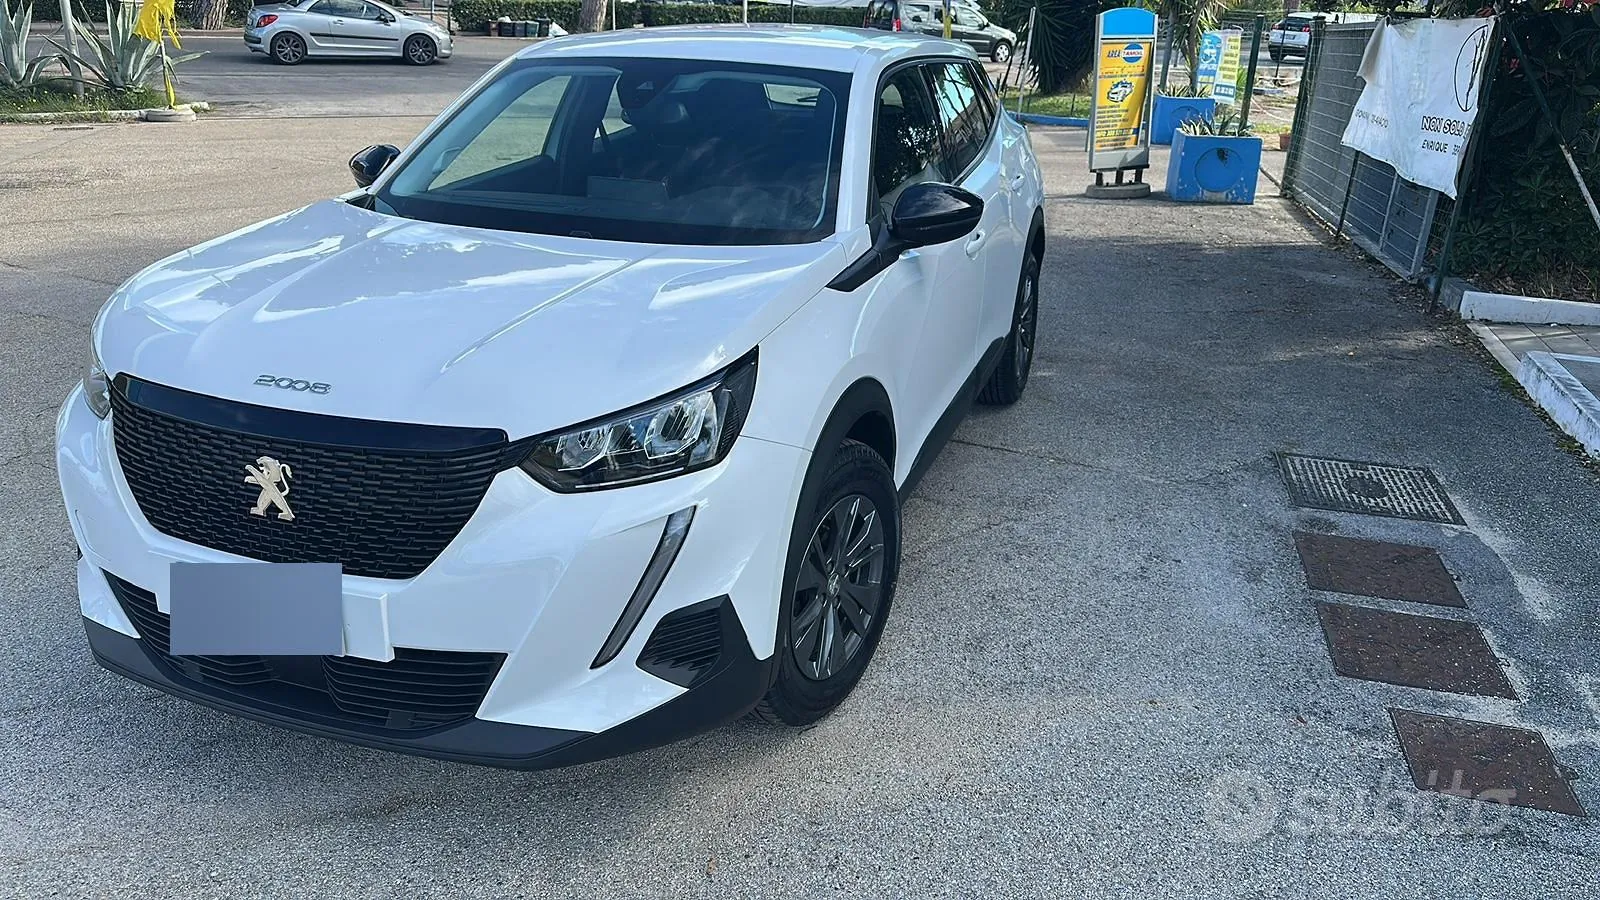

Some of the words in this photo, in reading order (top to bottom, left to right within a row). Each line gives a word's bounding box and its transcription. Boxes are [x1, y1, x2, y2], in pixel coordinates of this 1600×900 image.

[1421, 115, 1443, 132] NON
[1443, 119, 1465, 137] SOLO
[1422, 139, 1448, 153] ENRIQUE
[253, 374, 331, 394] 2008
